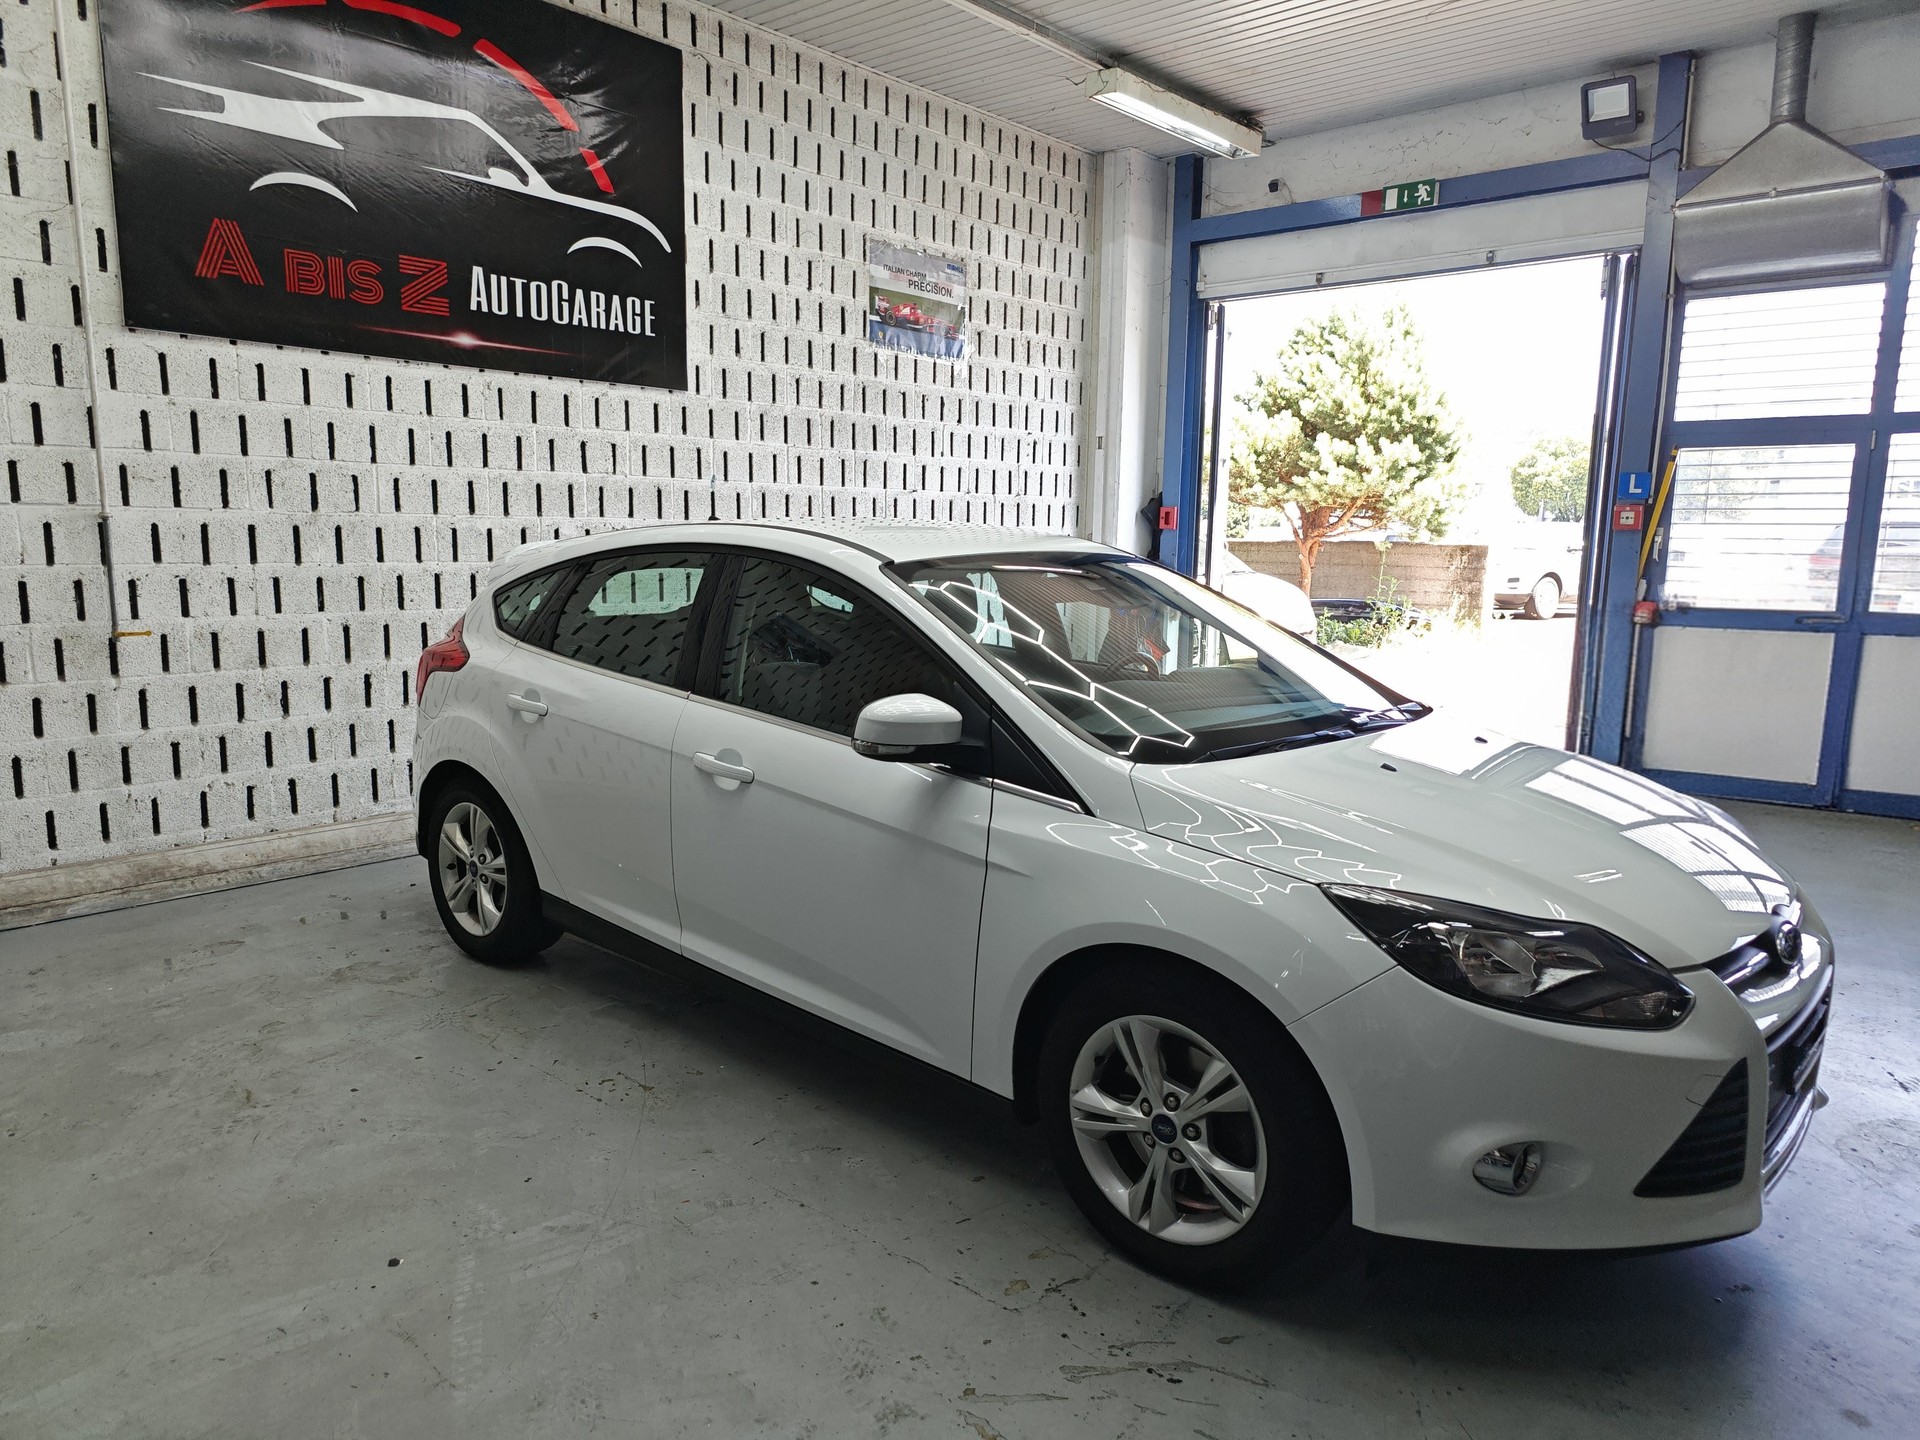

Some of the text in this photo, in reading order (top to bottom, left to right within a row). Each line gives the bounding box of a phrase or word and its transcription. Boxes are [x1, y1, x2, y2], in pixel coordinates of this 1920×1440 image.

[195, 218, 264, 286] A
[284, 248, 384, 305] BIS
[399, 254, 450, 316] Z
[883, 264, 905, 275] ITALIAN
[908, 279, 954, 298] PRECISION.
[1628, 474, 1642, 494] L
